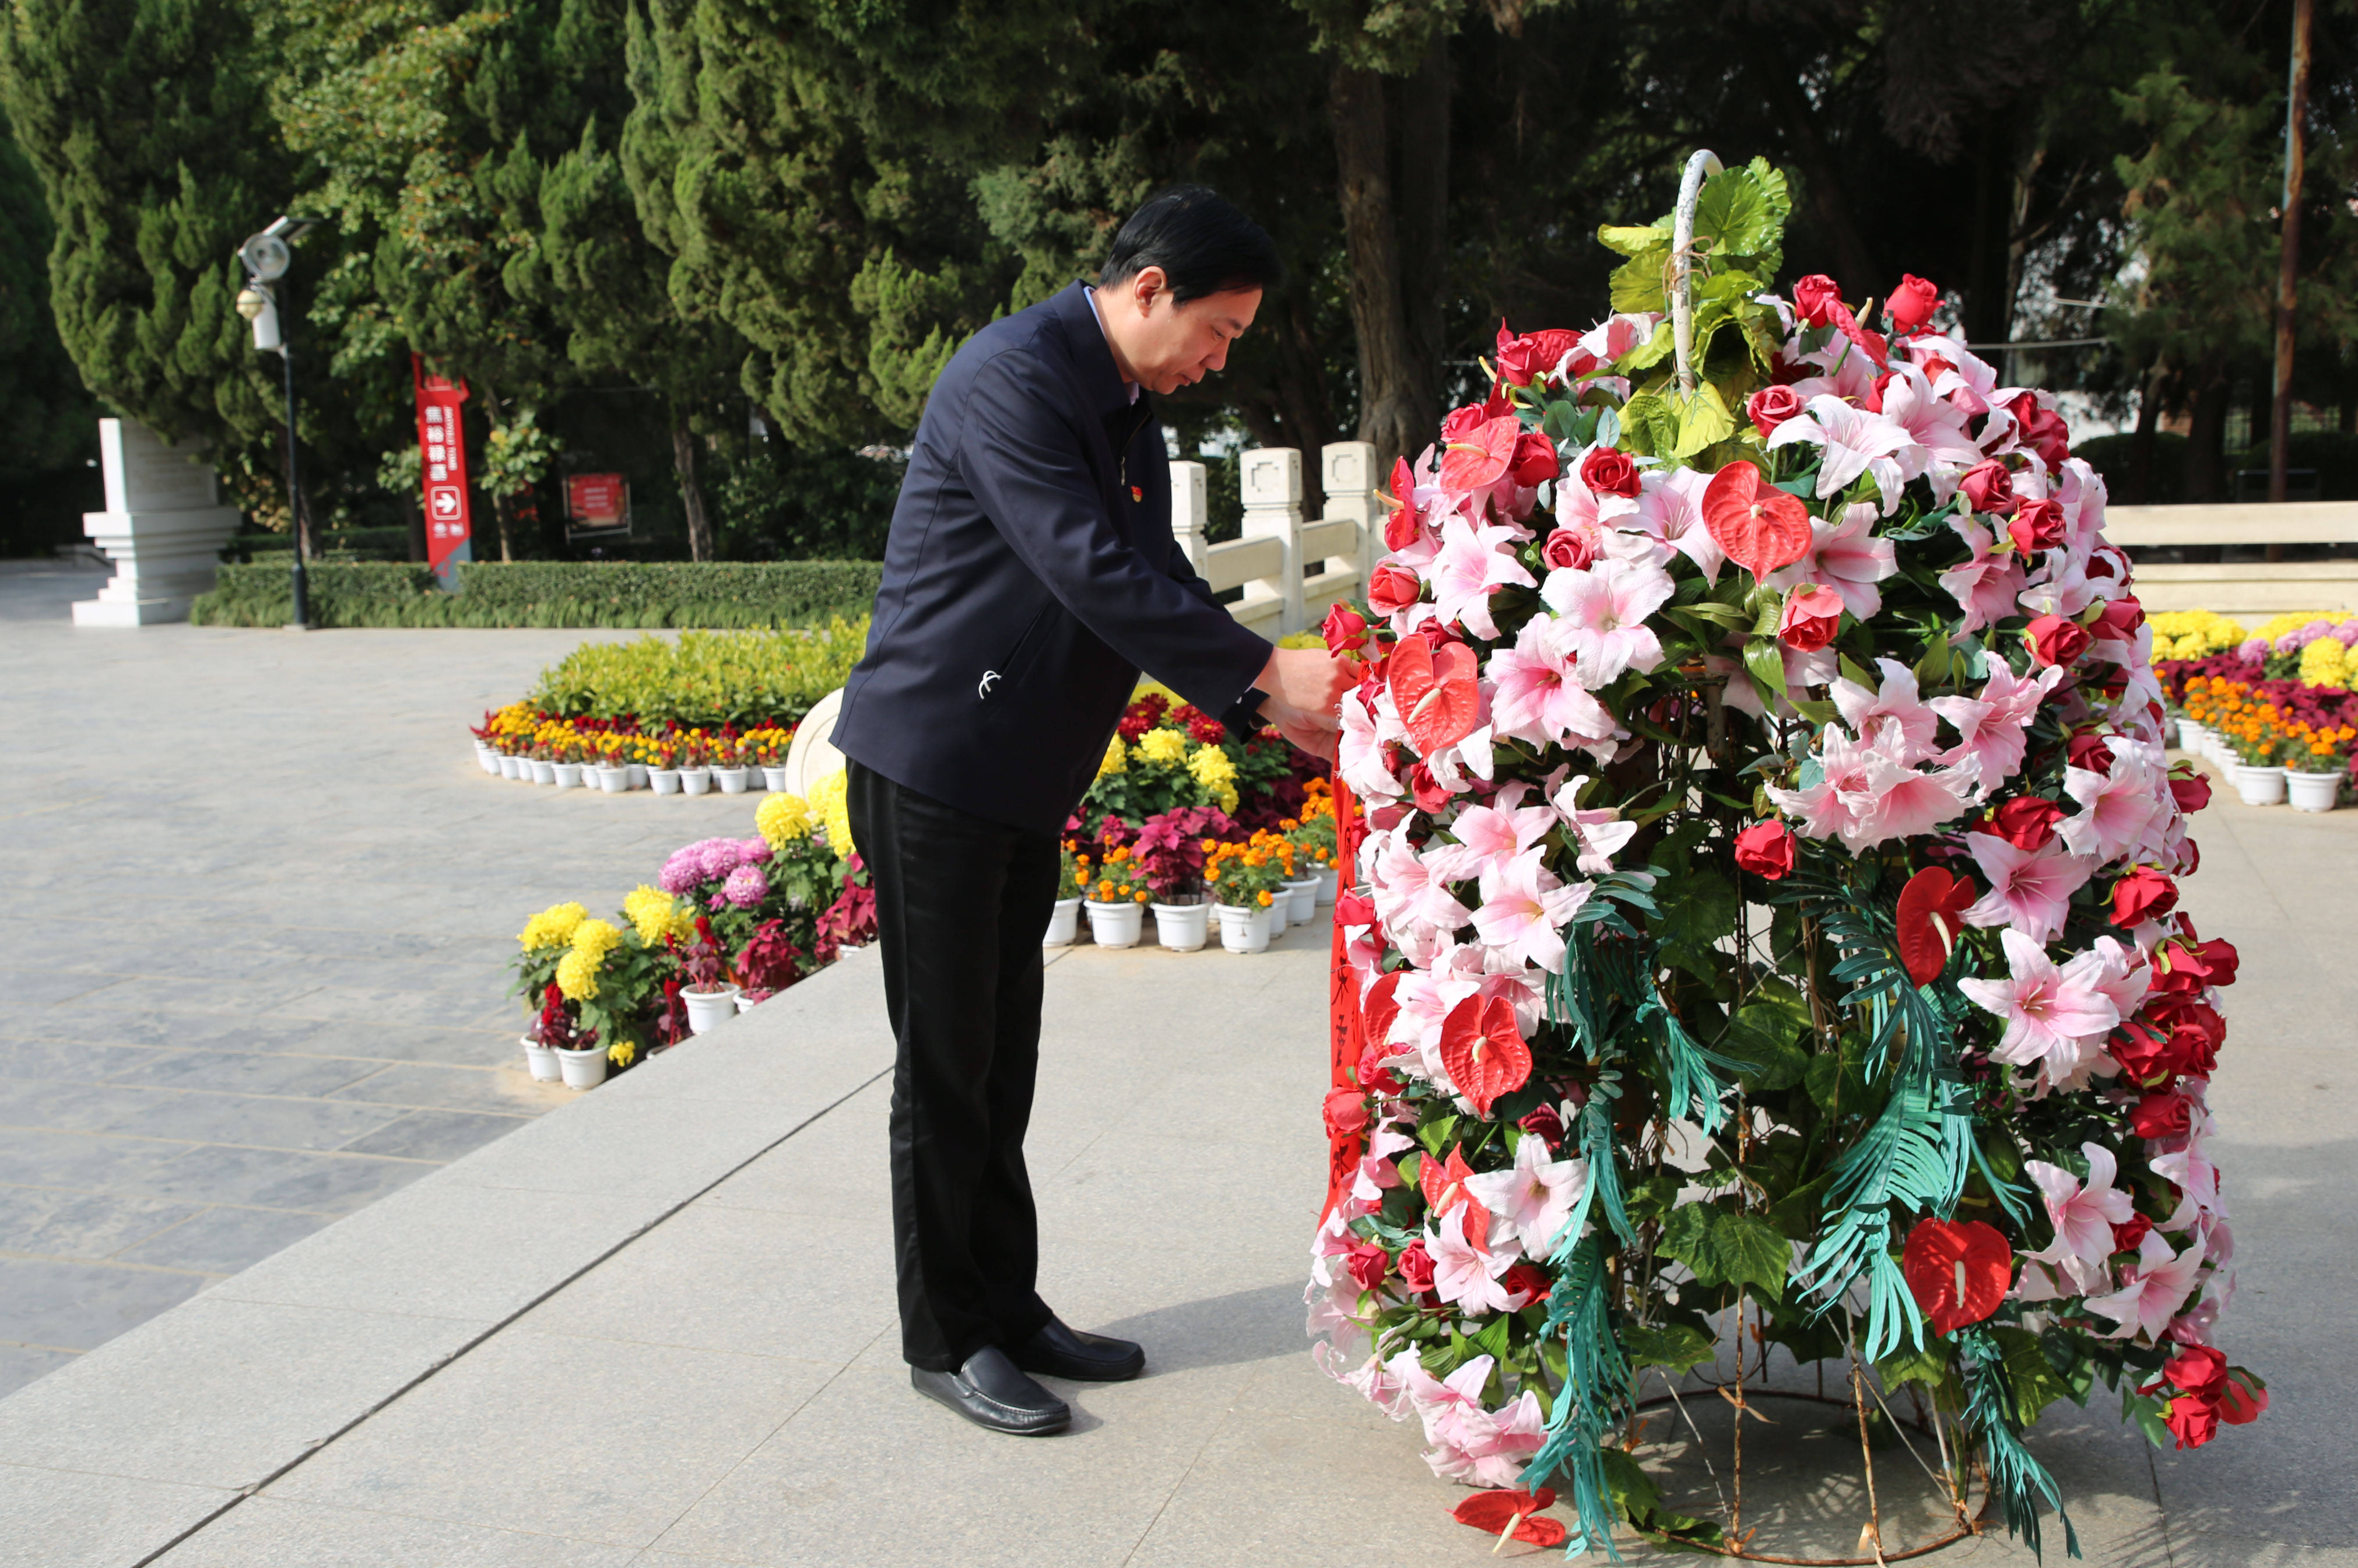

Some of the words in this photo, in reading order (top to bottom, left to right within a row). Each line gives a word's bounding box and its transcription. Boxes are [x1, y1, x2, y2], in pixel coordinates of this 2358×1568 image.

[425, 406, 448, 481] 焦裕禄墓
[447, 446, 457, 471] TOMB
